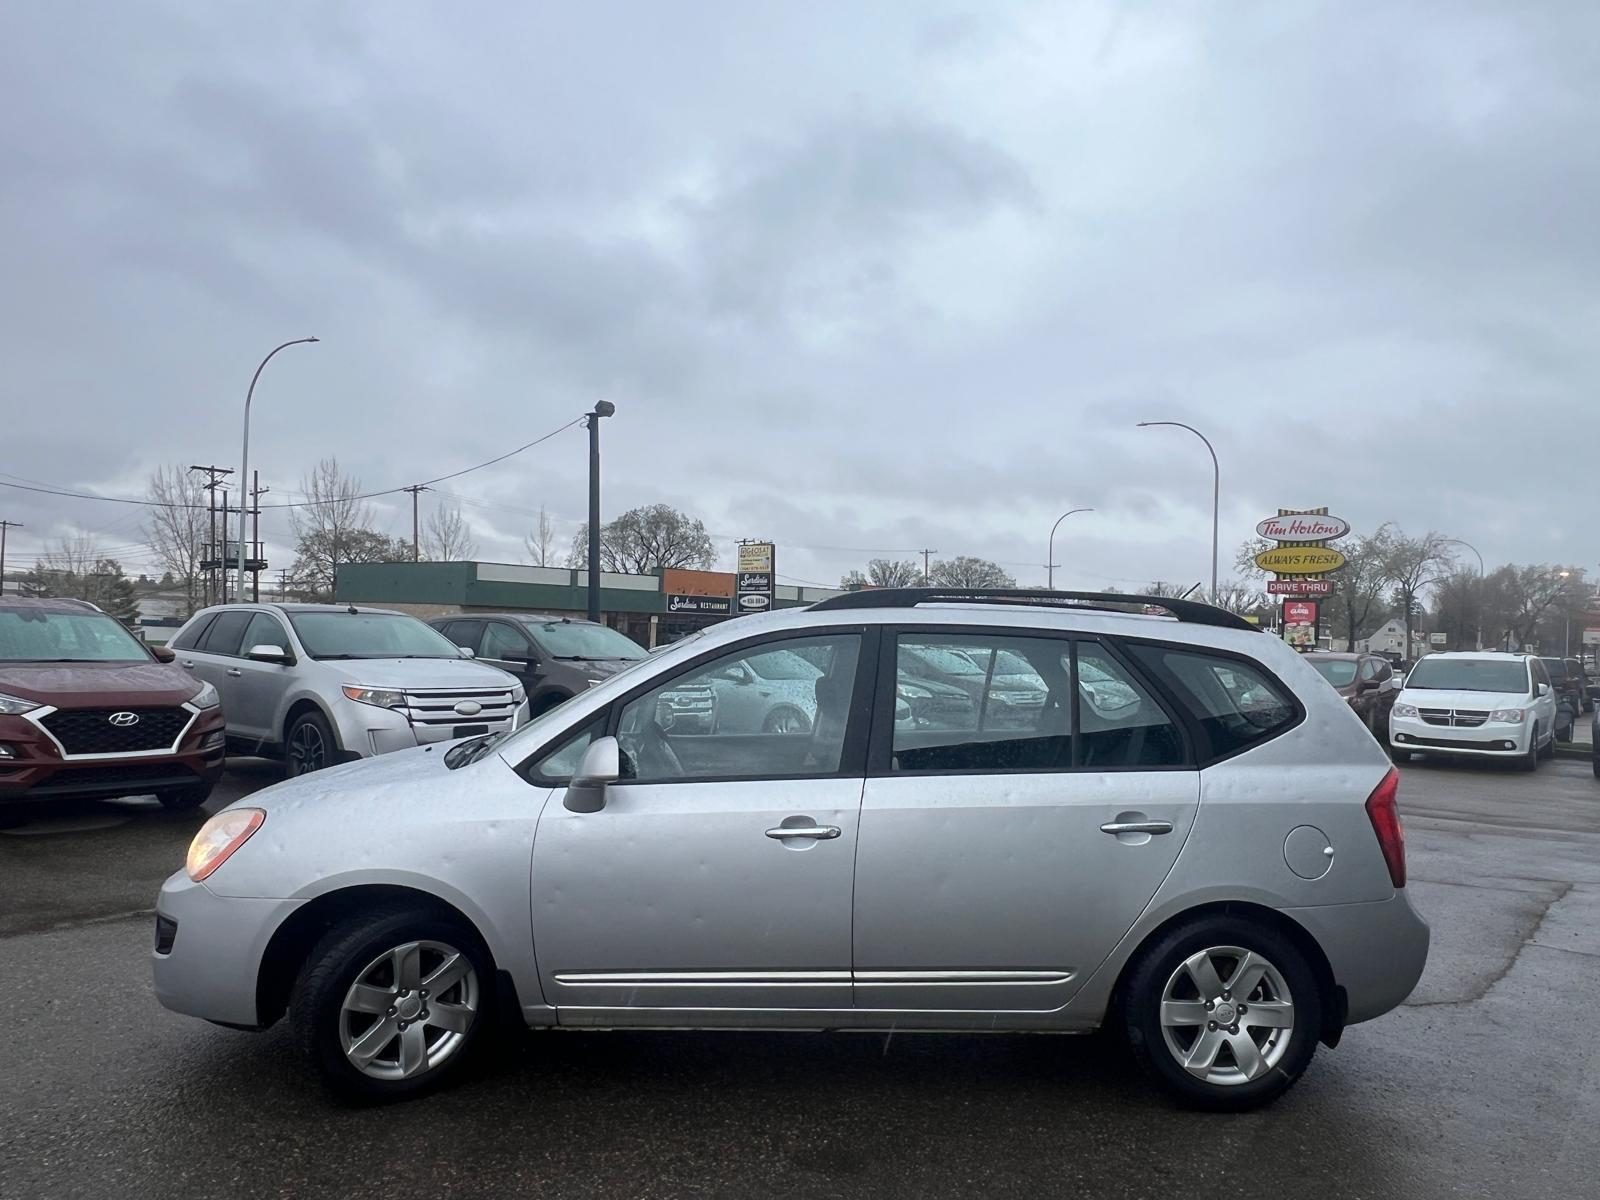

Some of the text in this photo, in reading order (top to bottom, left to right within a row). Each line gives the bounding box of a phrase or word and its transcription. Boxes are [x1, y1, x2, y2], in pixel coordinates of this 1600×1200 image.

[1263, 520, 1339, 535] Tim Hortons
[1261, 554, 1338, 565] ALWAYS FRESH
[1270, 583, 1328, 592] DRIVE THRU
